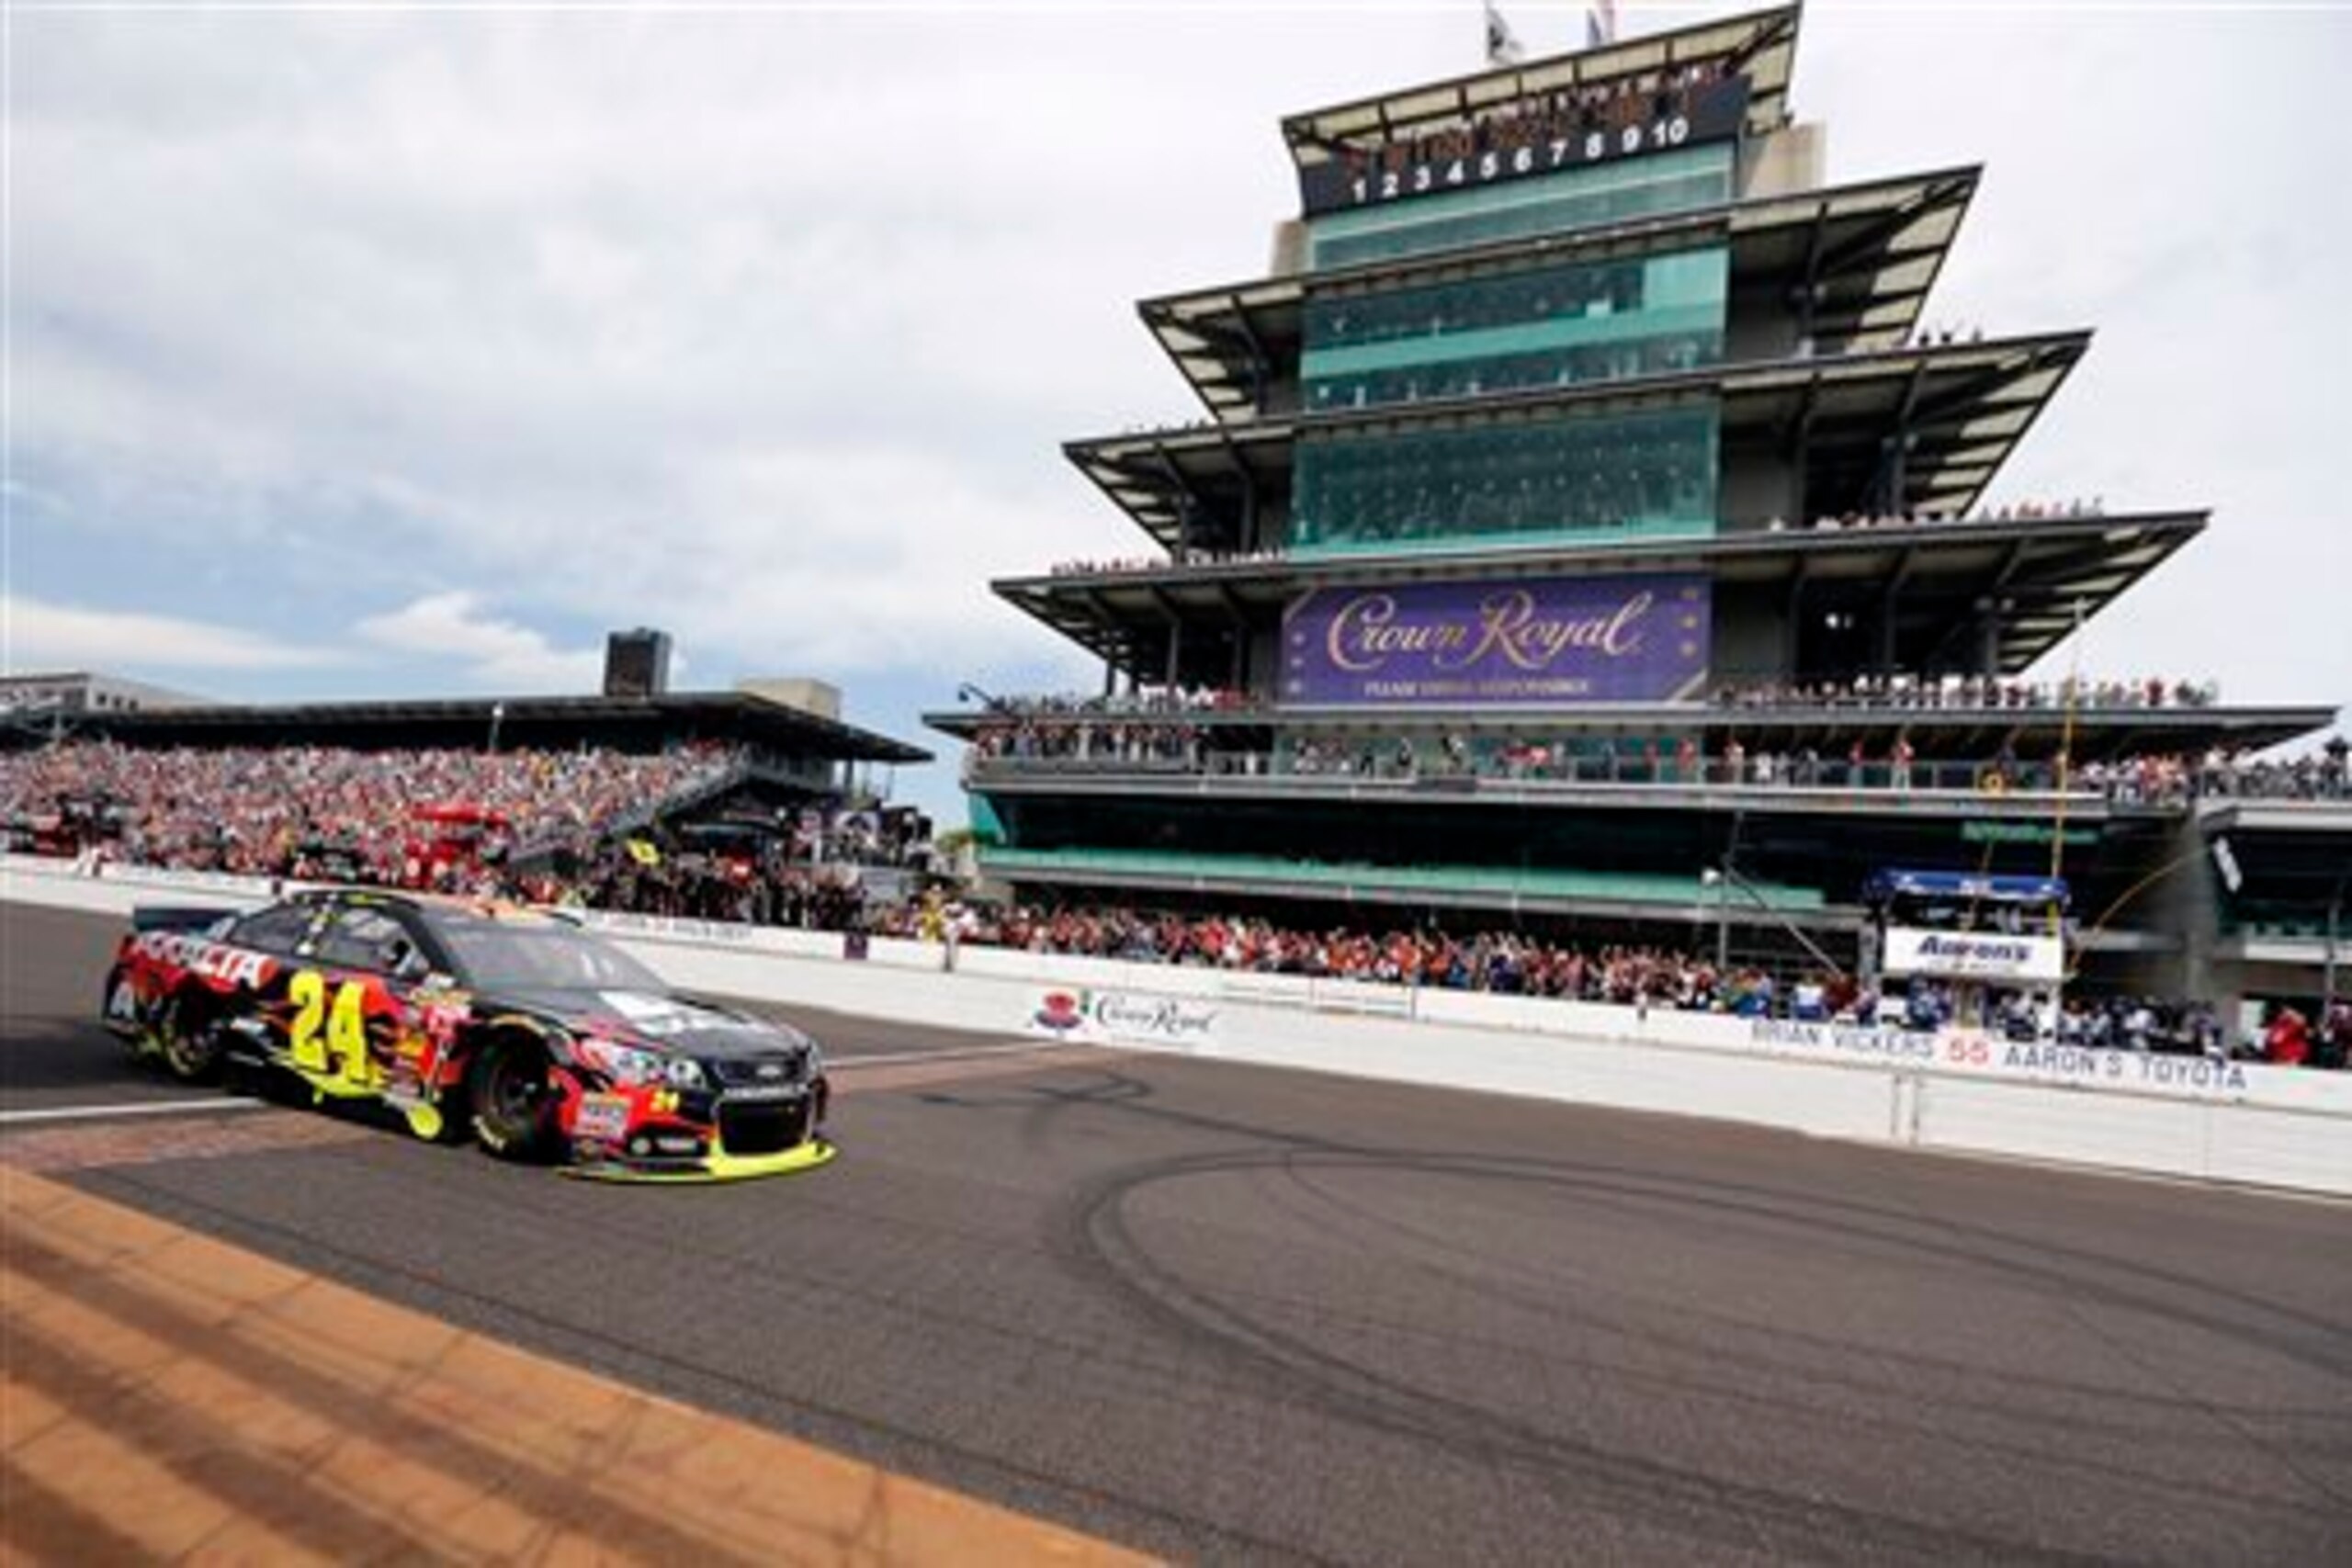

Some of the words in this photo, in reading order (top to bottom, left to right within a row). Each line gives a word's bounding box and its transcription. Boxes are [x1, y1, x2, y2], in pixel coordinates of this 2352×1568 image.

[1353, 177, 1367, 204] 1
[1382, 172, 1399, 198] 2
[1414, 164, 1431, 191] 3
[1447, 158, 1464, 184] 4
[1480, 151, 1499, 180] 5
[1513, 145, 1533, 173] 6
[1549, 138, 1568, 167] 7
[1585, 131, 1605, 160] 8
[1621, 124, 1643, 154] 9
[1653, 116, 1690, 149] 10
[1327, 593, 1467, 671] Crown
[1433, 589, 1653, 671] Royal
[288, 970, 368, 1084] 24
[1948, 1036, 1991, 1066] 55
[2139, 1054, 2247, 1091] TOYOTA
